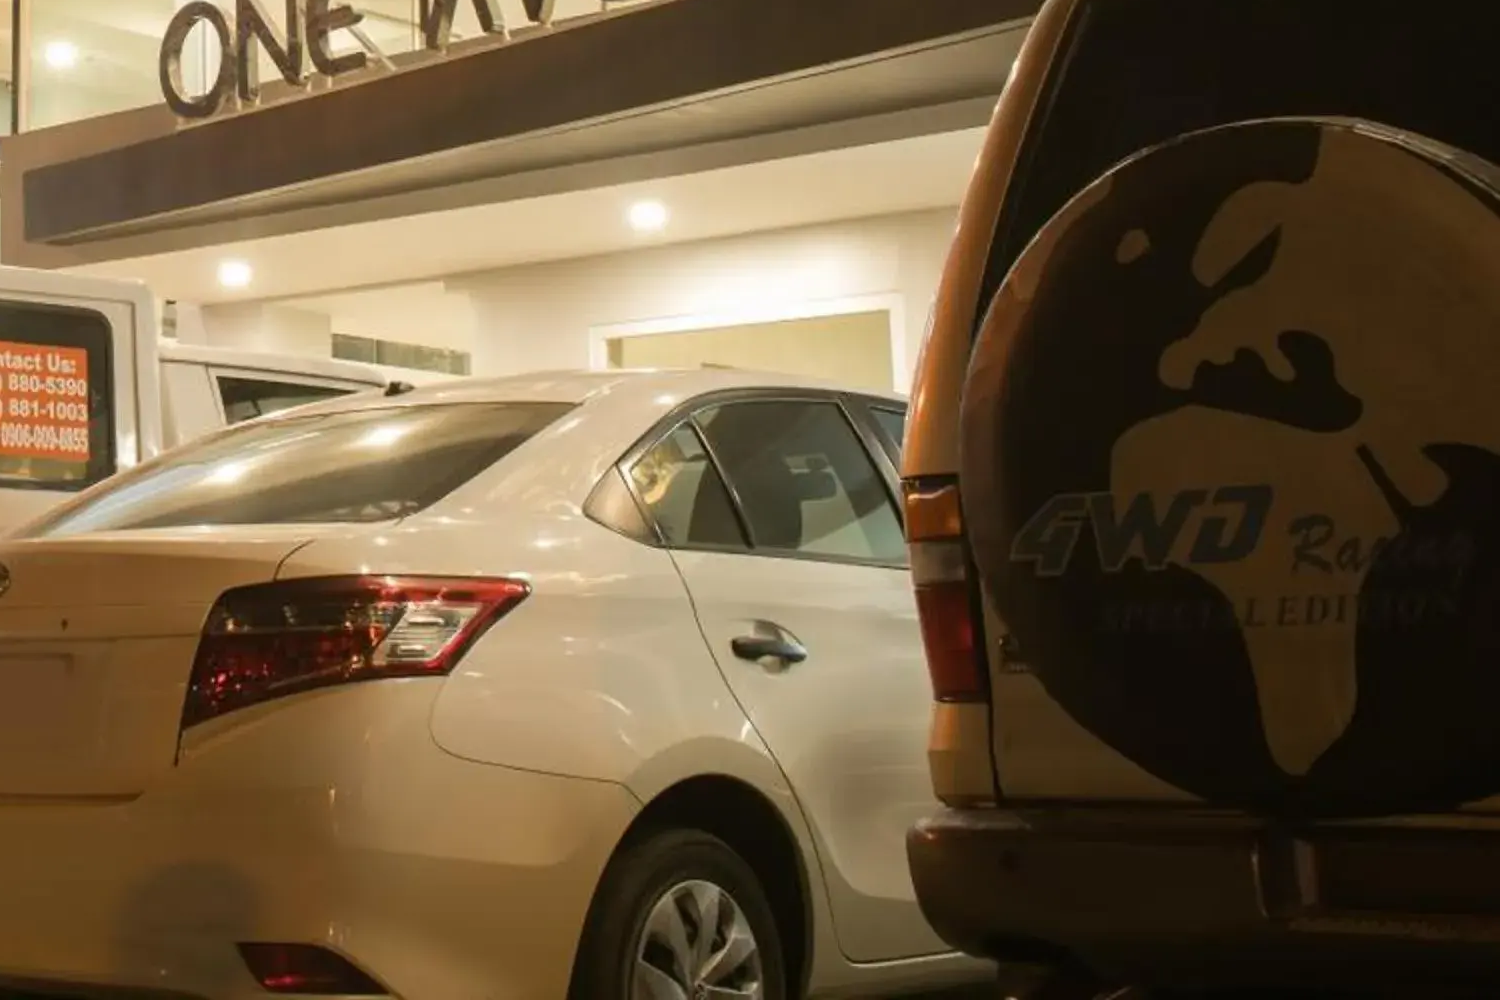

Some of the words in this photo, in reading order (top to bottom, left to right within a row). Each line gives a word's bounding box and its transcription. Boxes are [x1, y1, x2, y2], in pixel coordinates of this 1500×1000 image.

[47, 352, 77, 374] Us:
[8, 373, 88, 397] 880-5390
[8, 398, 88, 422] 881-1003
[1008, 482, 1275, 578] 4WD
[1288, 513, 1478, 592] Racing
